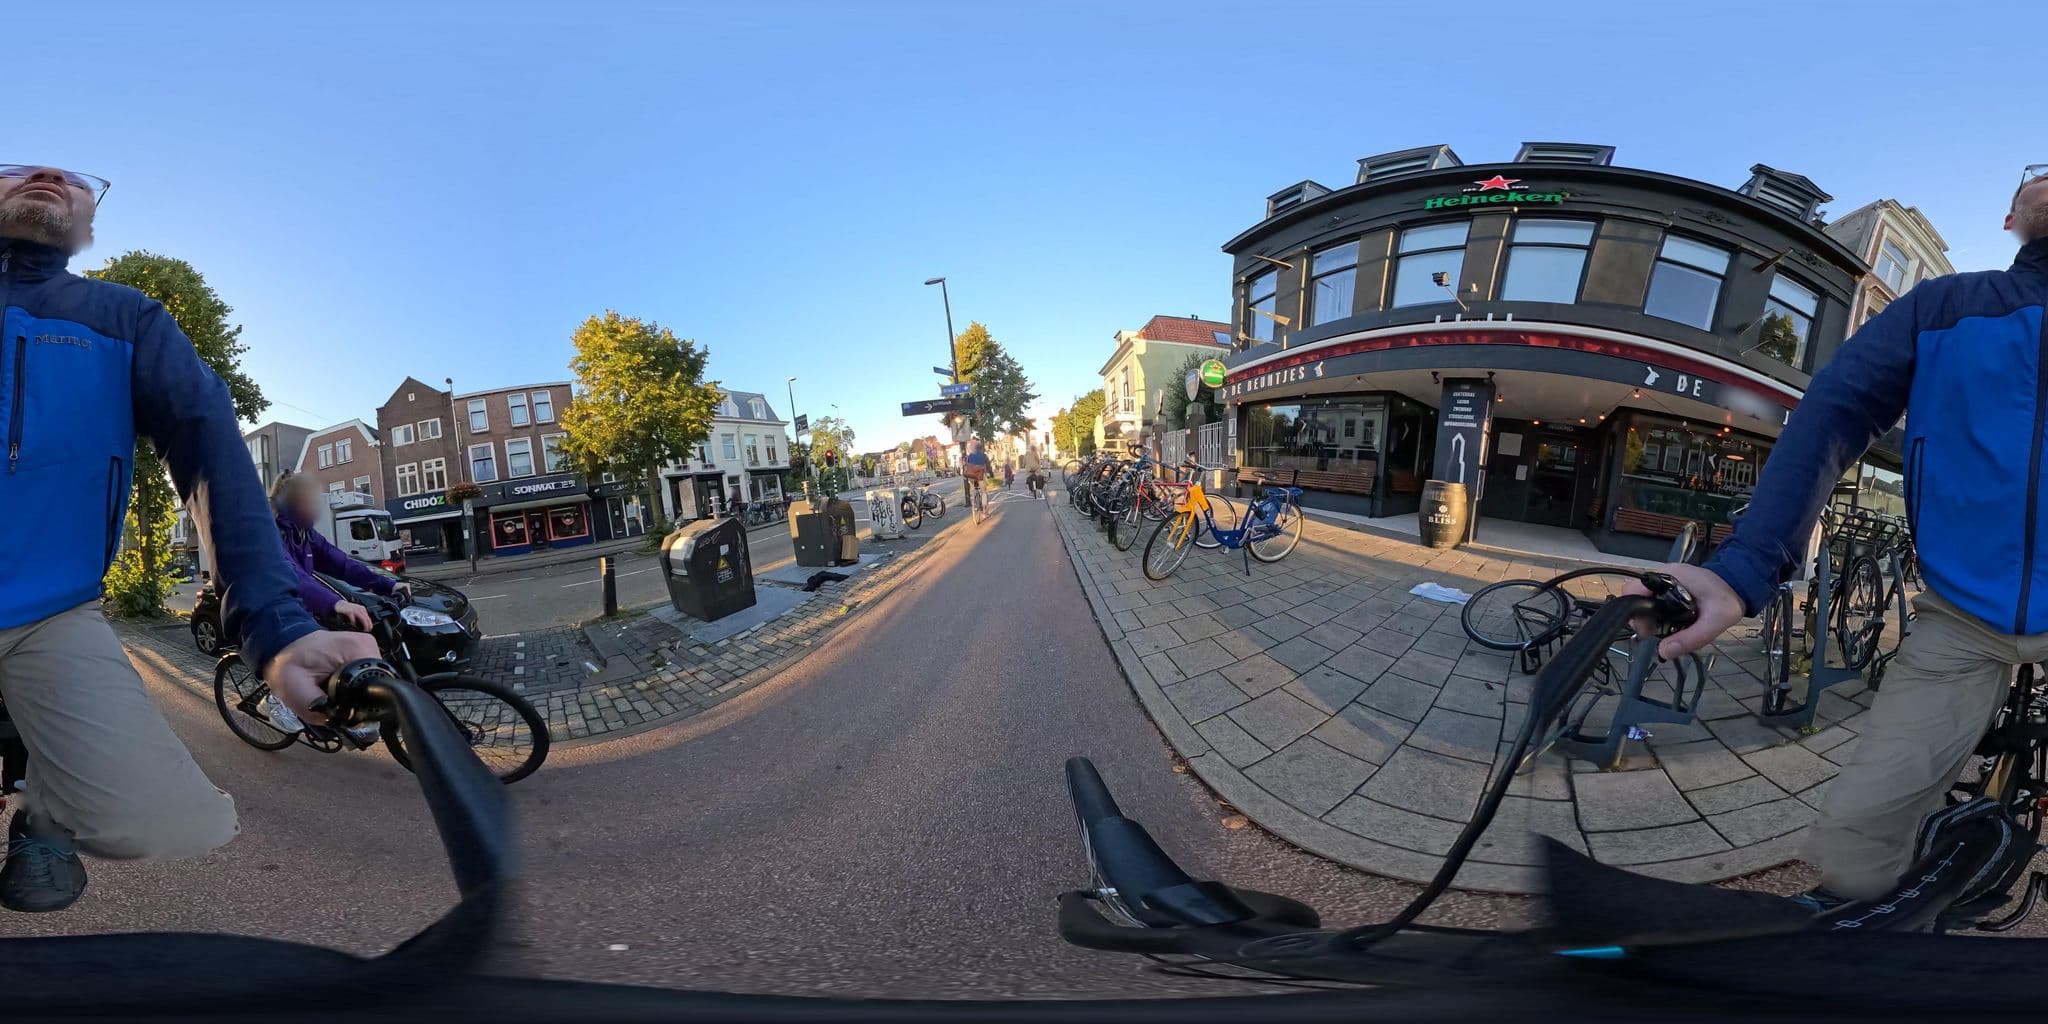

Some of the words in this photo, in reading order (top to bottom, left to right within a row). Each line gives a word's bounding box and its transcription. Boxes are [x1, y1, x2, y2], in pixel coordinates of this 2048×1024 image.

[1423, 191, 1563, 210] Heineken
[1231, 383, 1242, 396] DE
[1676, 375, 1703, 397] DE
[1428, 516, 1457, 525] BLISS
